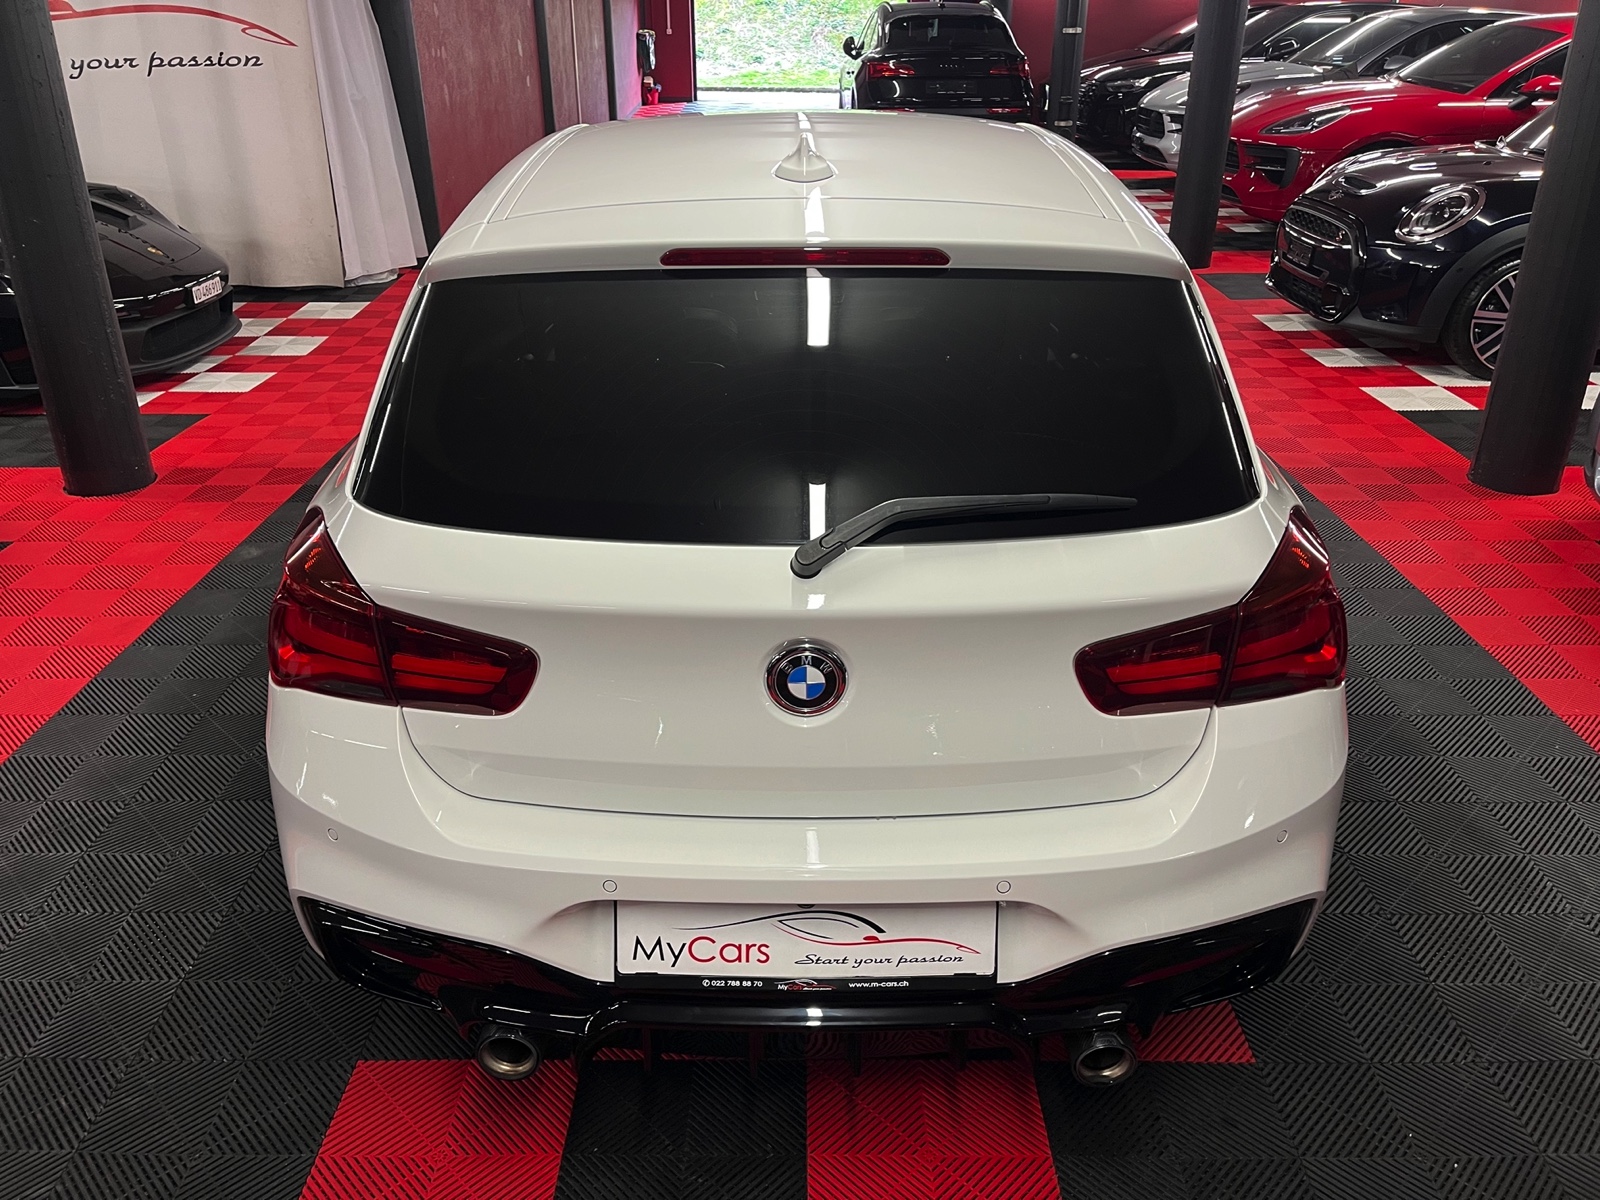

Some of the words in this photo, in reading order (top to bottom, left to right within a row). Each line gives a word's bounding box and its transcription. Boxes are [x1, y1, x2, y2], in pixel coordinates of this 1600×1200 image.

[69, 56, 139, 79] your
[147, 51, 263, 77] passion
[780, 655, 833, 675] BMW
[632, 935, 771, 968] MyCars
[794, 953, 849, 965] Start
[851, 956, 893, 969] your
[896, 954, 964, 967] passion
[848, 980, 909, 988] www.m-cars.ch
